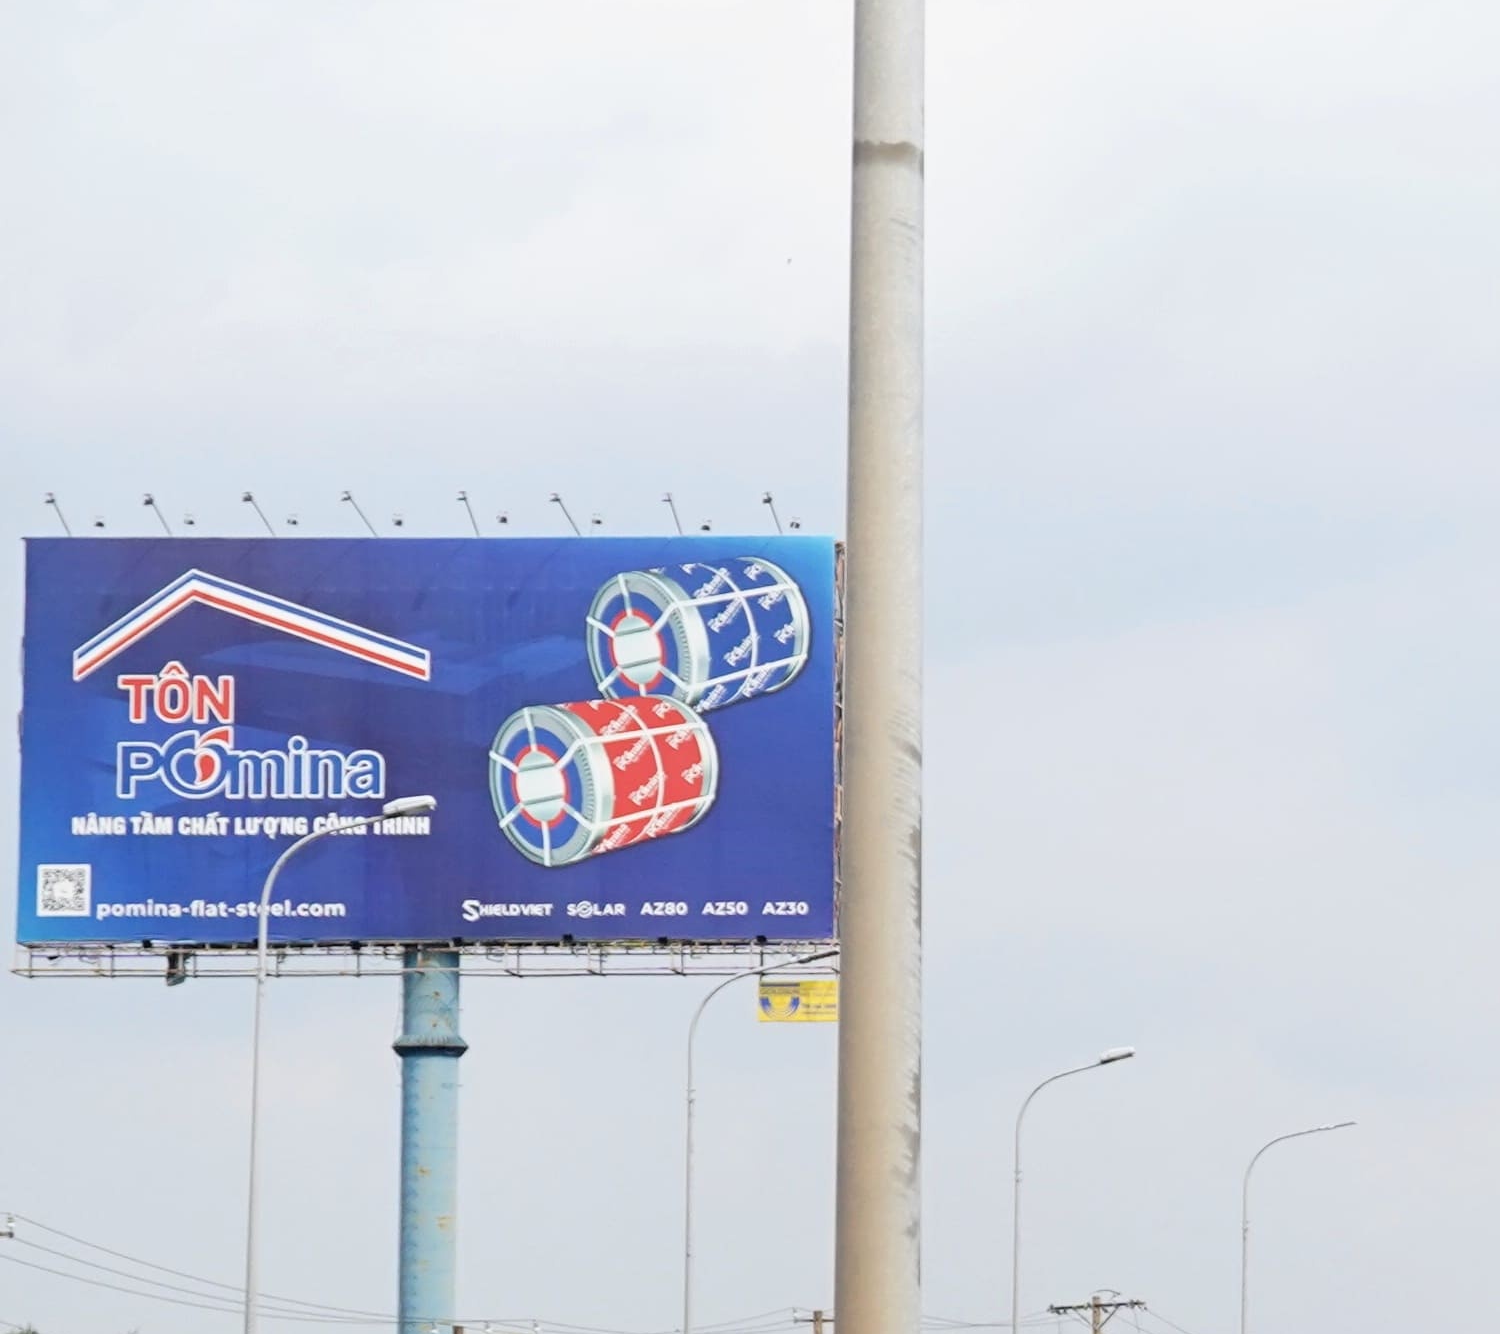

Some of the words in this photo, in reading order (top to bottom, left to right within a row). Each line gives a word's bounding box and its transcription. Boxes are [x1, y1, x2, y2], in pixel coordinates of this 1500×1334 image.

[117, 660, 234, 724] TÔN
[72, 813, 126, 835] NÂNG
[130, 811, 173, 835] TẦM
[178, 812, 229, 835] CHẤT
[234, 815, 308, 840] LƯỢNG
[641, 901, 688, 916] AZ80
[702, 901, 748, 916] AZ50
[762, 901, 808, 916] AZ30
